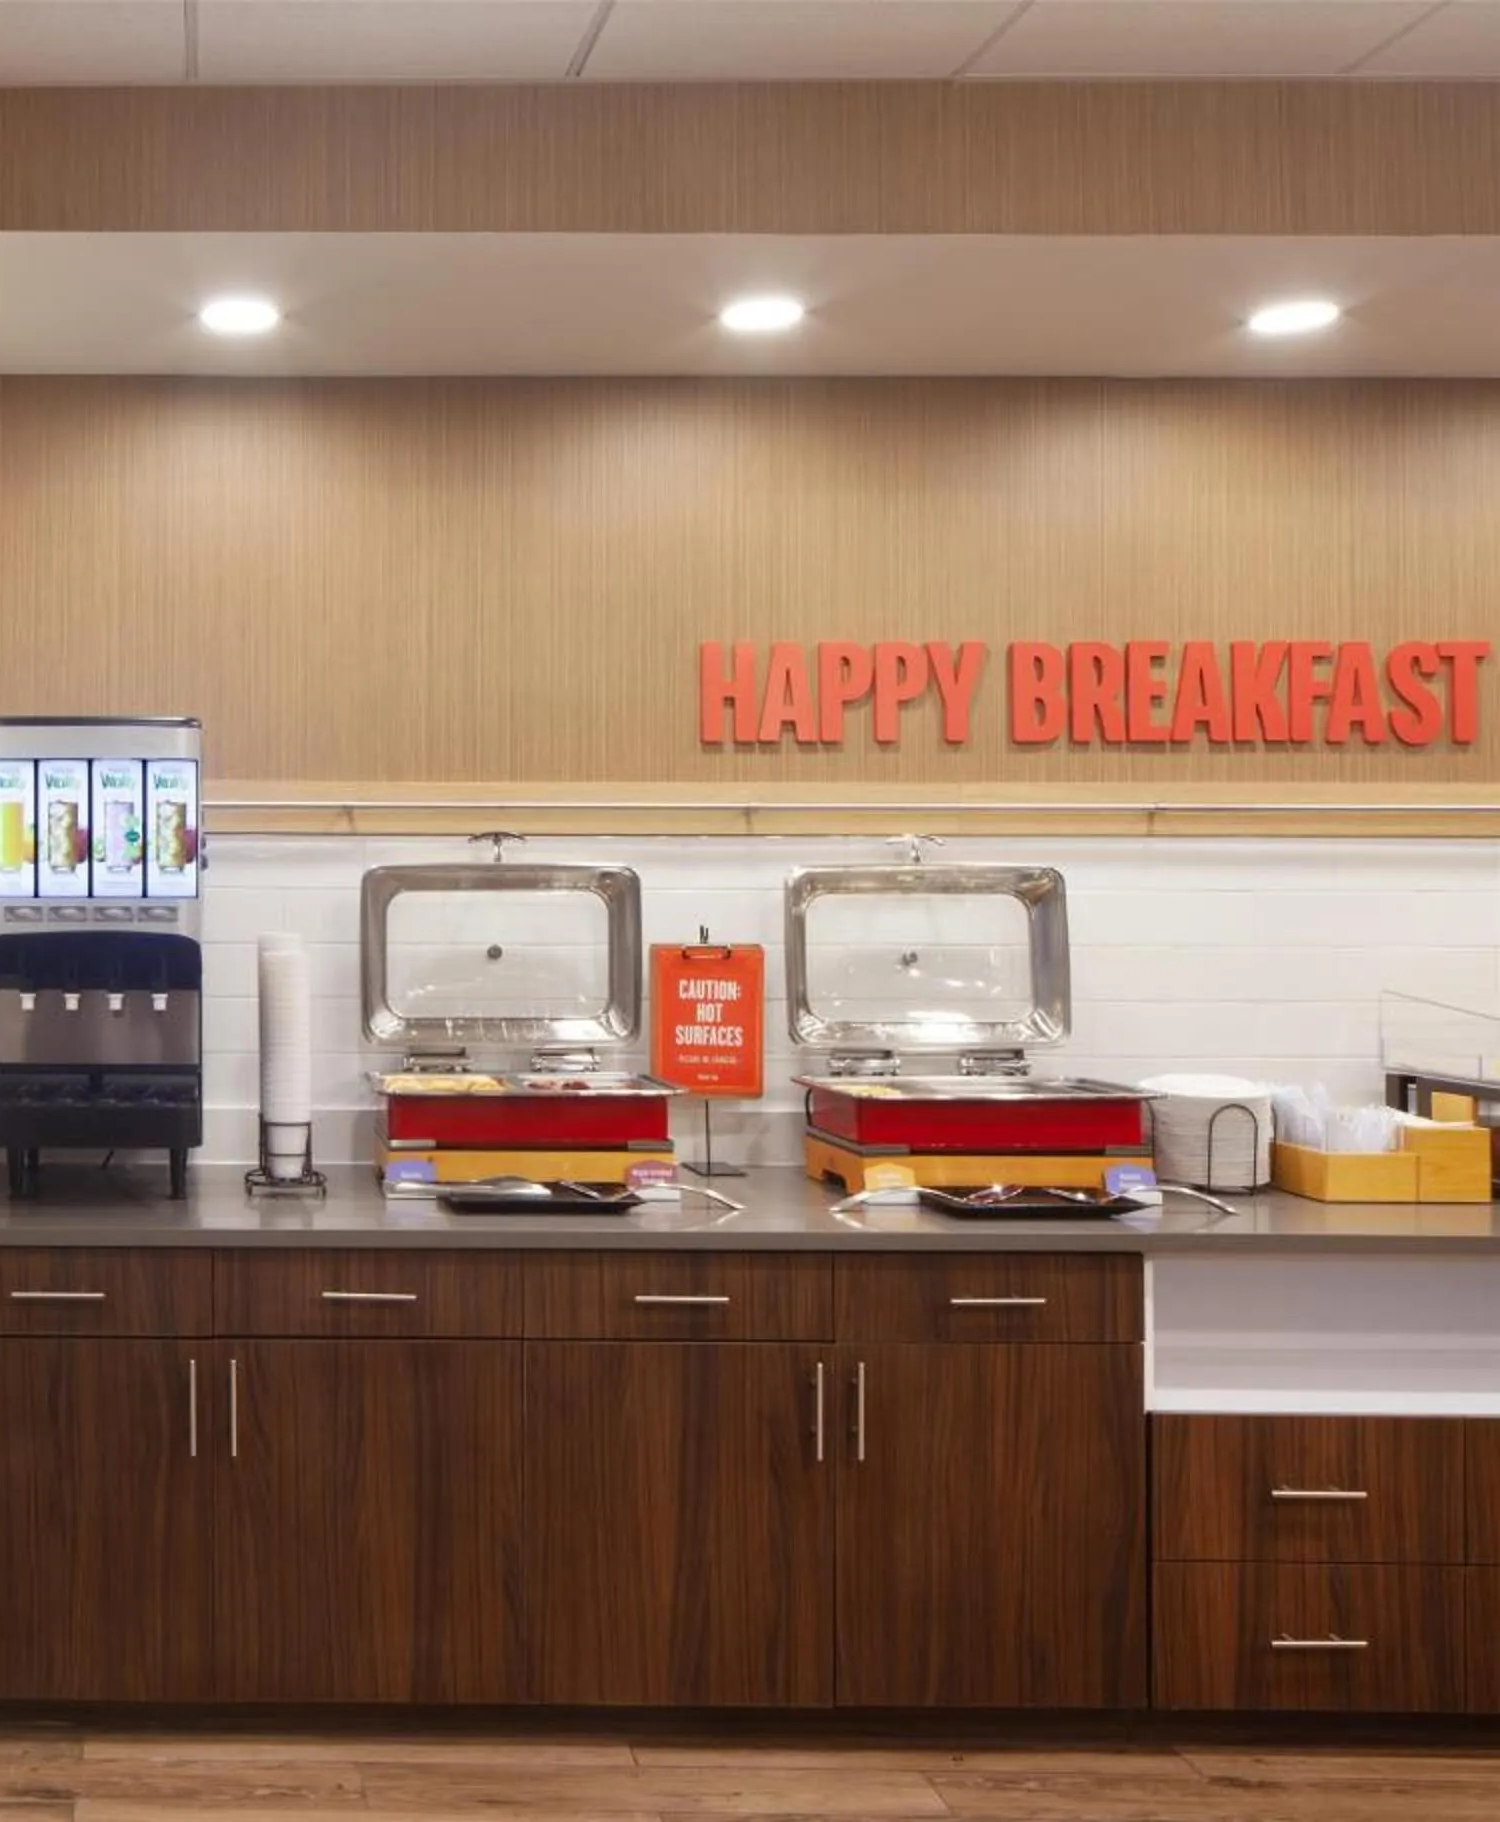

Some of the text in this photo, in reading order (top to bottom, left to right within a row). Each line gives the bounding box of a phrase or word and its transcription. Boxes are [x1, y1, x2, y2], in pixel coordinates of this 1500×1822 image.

[699, 640, 1492, 748] HAPPY BREAKFAST
[678, 979, 741, 1000] CAUTION:
[696, 1002, 723, 1022] HOT
[675, 1025, 743, 1047] SURFACES
